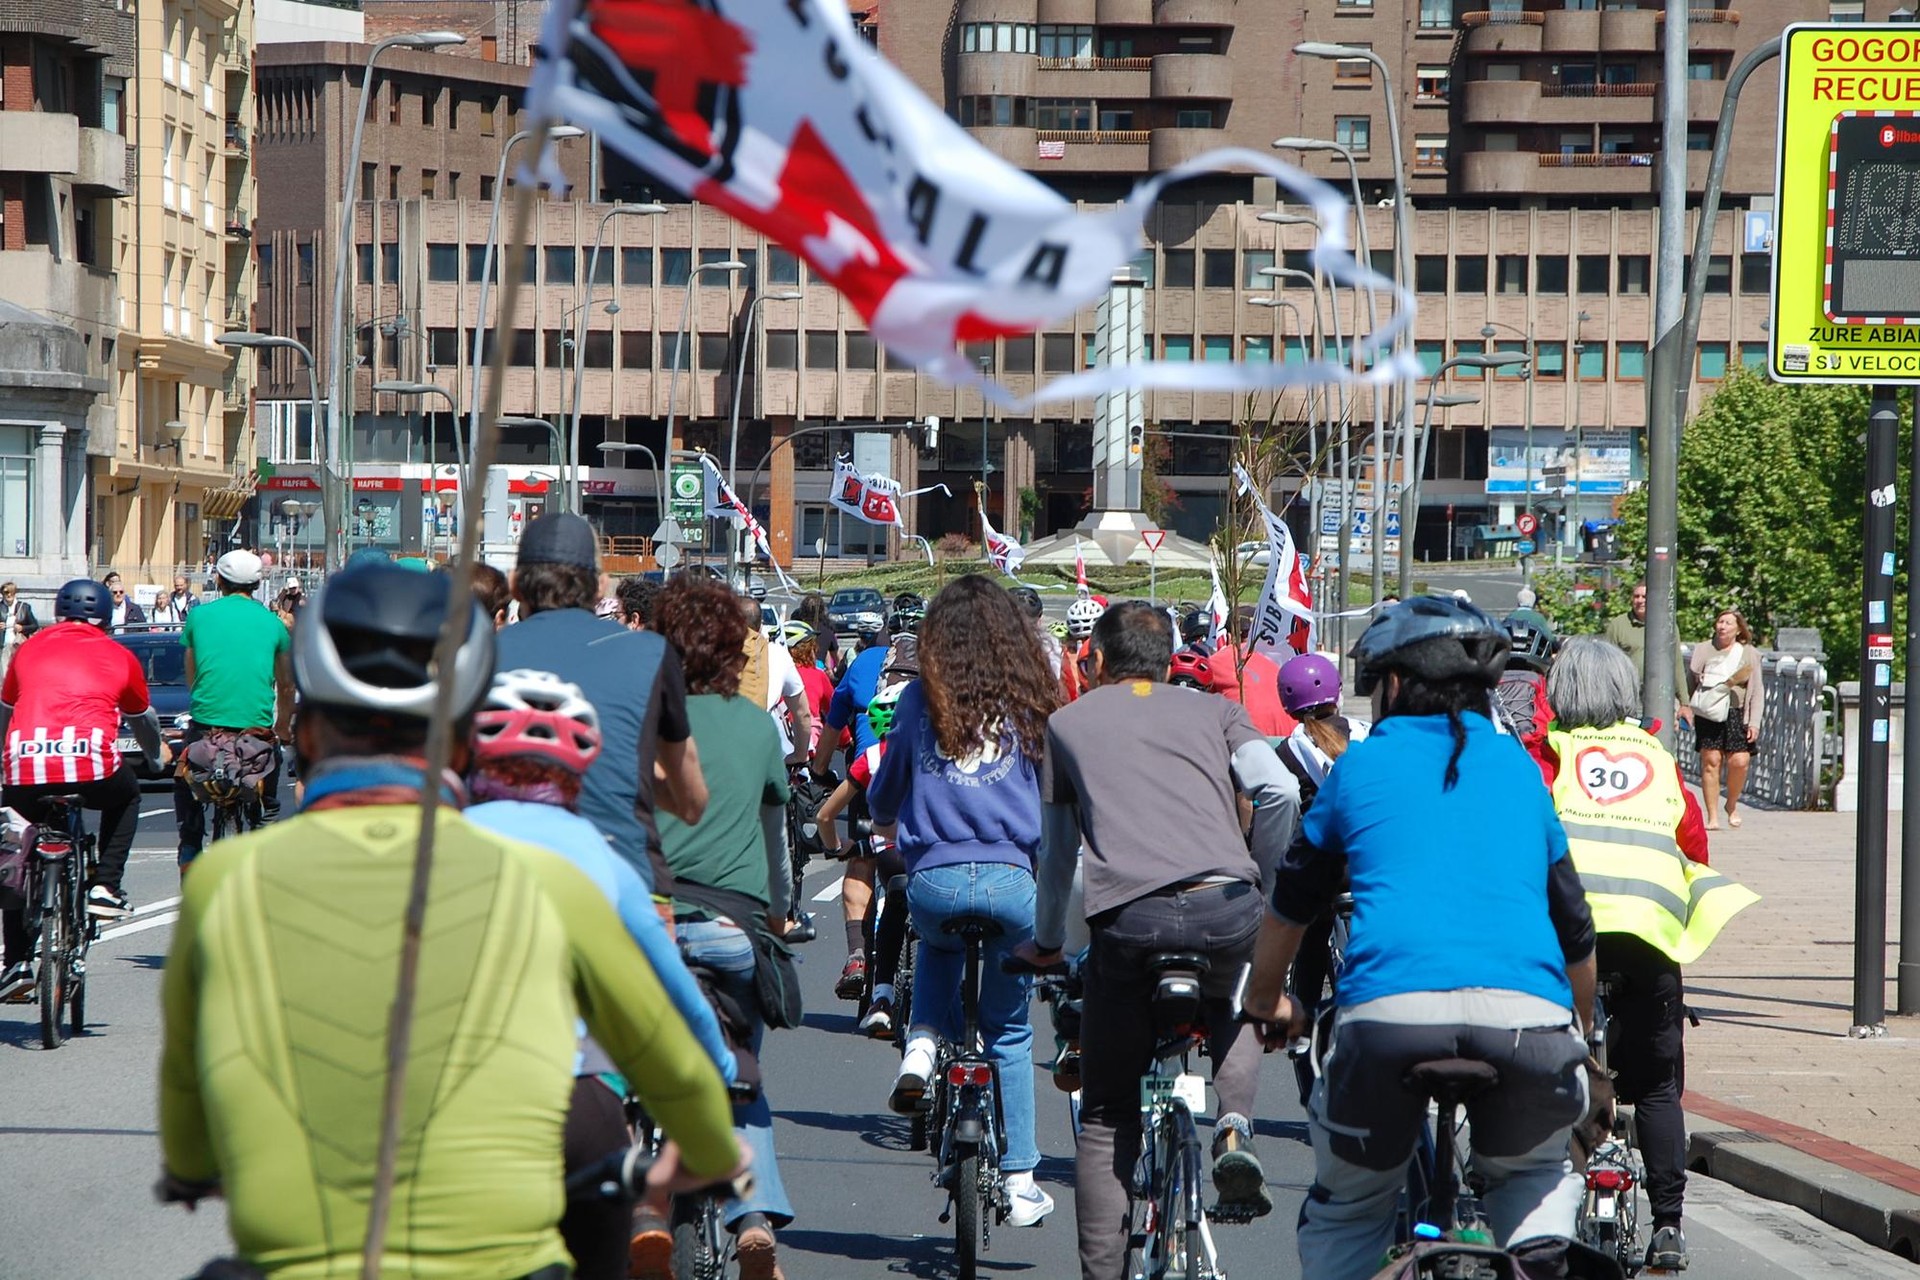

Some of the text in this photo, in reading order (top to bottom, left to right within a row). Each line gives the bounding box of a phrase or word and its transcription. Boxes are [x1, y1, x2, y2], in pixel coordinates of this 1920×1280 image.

[1883, 130, 1920, 143] Bilba
[1809, 327, 1920, 345] ZURE ABIA
[282, 479, 308, 488] MAPFRE
[357, 479, 384, 488] MAPFRE
[20, 740, 87, 756] DIGI
[946, 770, 980, 788] THE
[1588, 767, 1629, 790] 30
